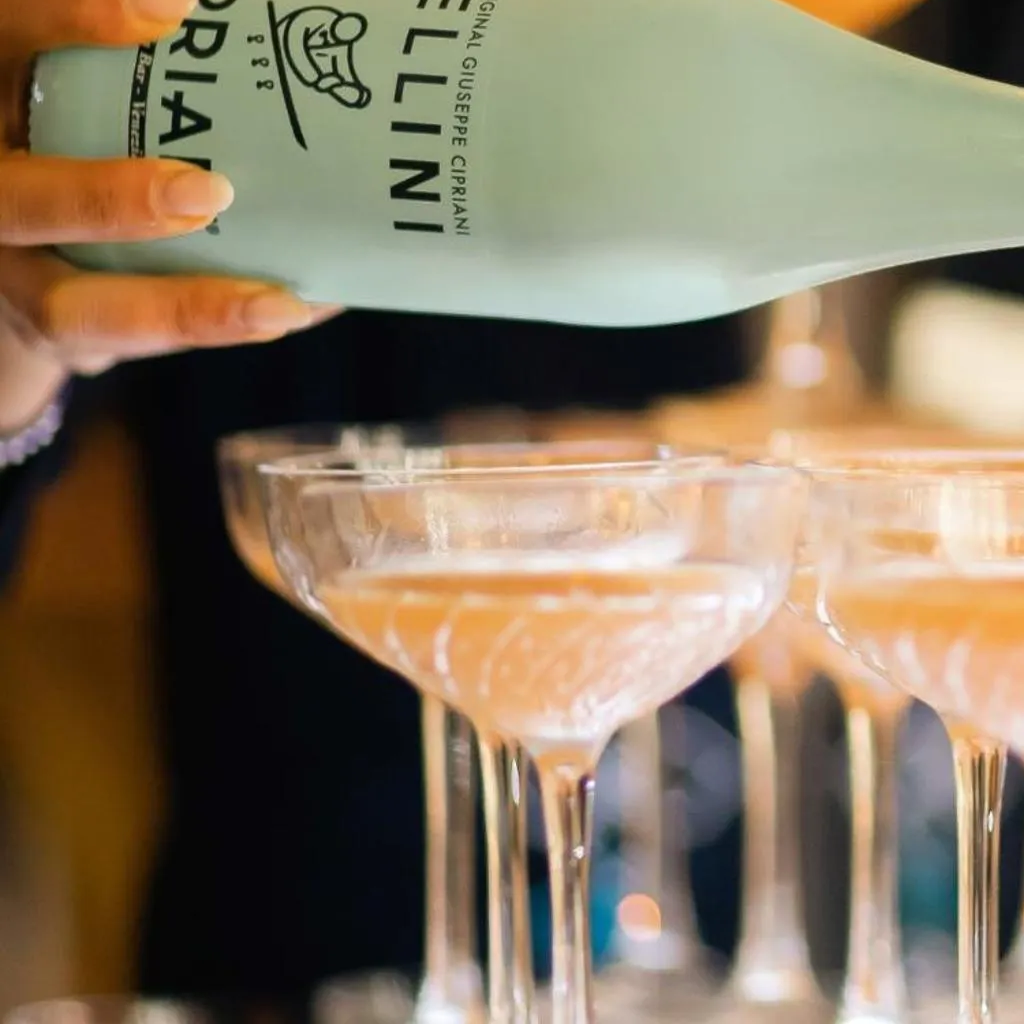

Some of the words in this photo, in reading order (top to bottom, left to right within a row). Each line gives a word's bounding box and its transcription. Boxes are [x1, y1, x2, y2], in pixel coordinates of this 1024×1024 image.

[136, 51, 152, 84] Bar
[451, 56, 478, 147] GIUSEPPE
[131, 101, 146, 157] Venezi
[450, 154, 471, 236] CIPRIANI
